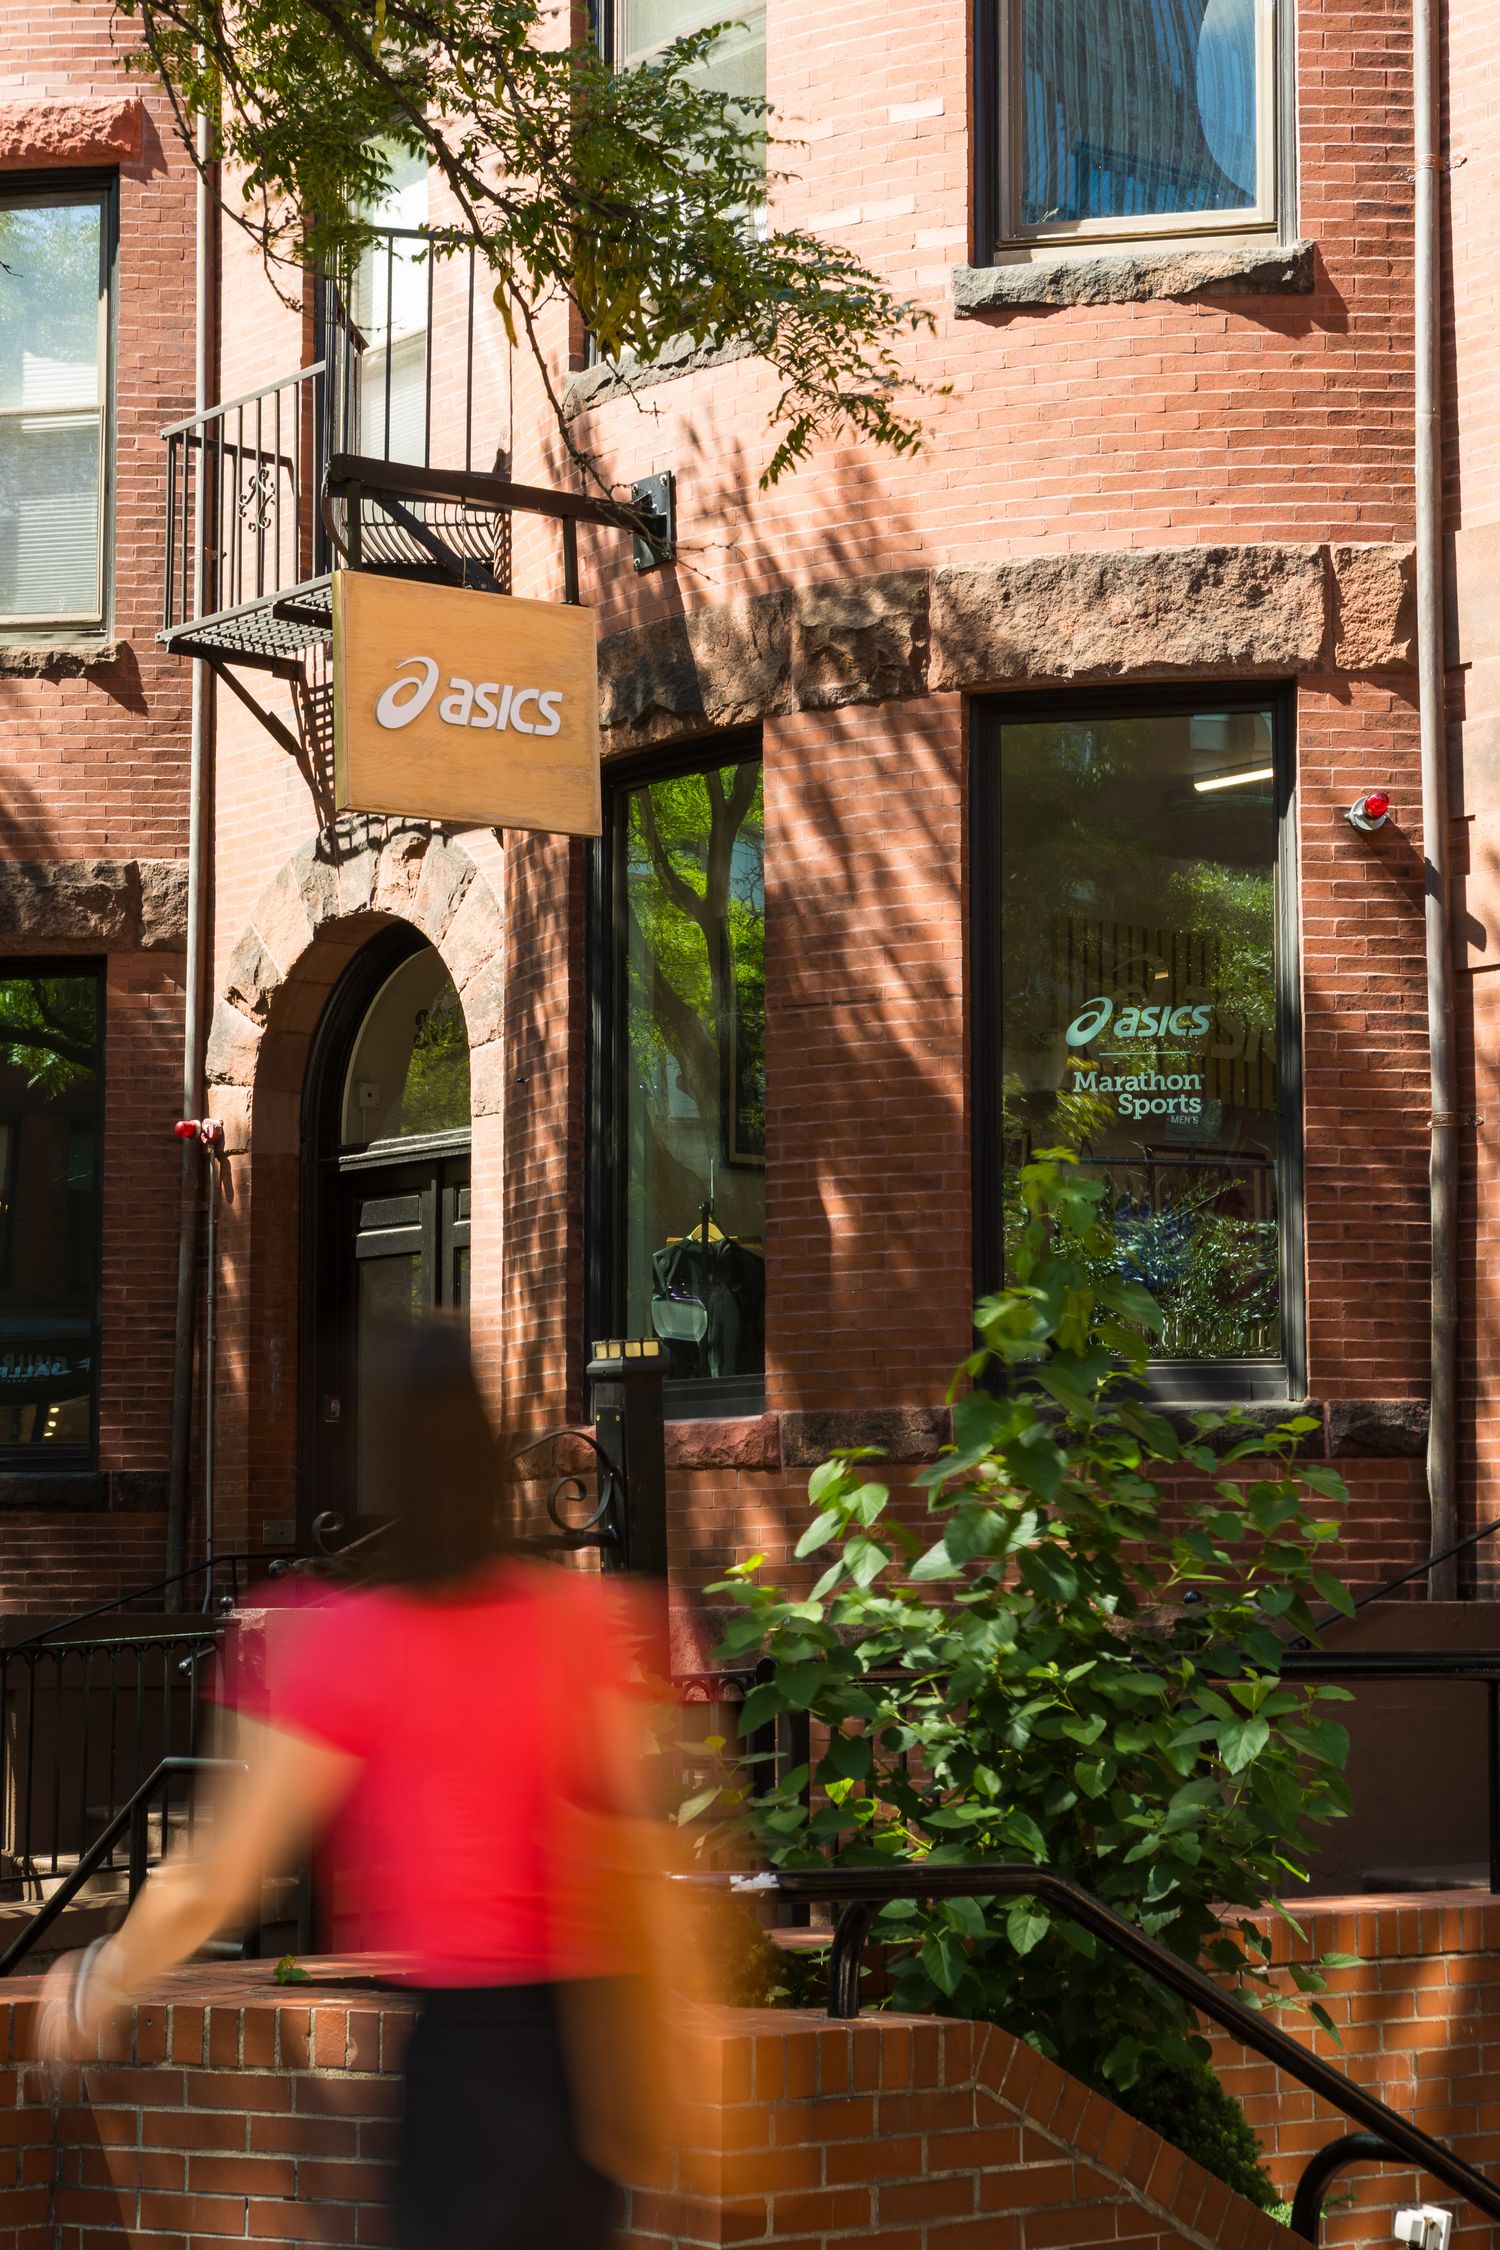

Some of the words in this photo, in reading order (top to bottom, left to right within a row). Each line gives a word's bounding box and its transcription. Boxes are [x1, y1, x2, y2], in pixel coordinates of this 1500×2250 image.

[1073, 1070, 1202, 1092] Marathon
[1118, 1093, 1201, 1119] Sports
[1170, 1115, 1199, 1125] MEN'S
